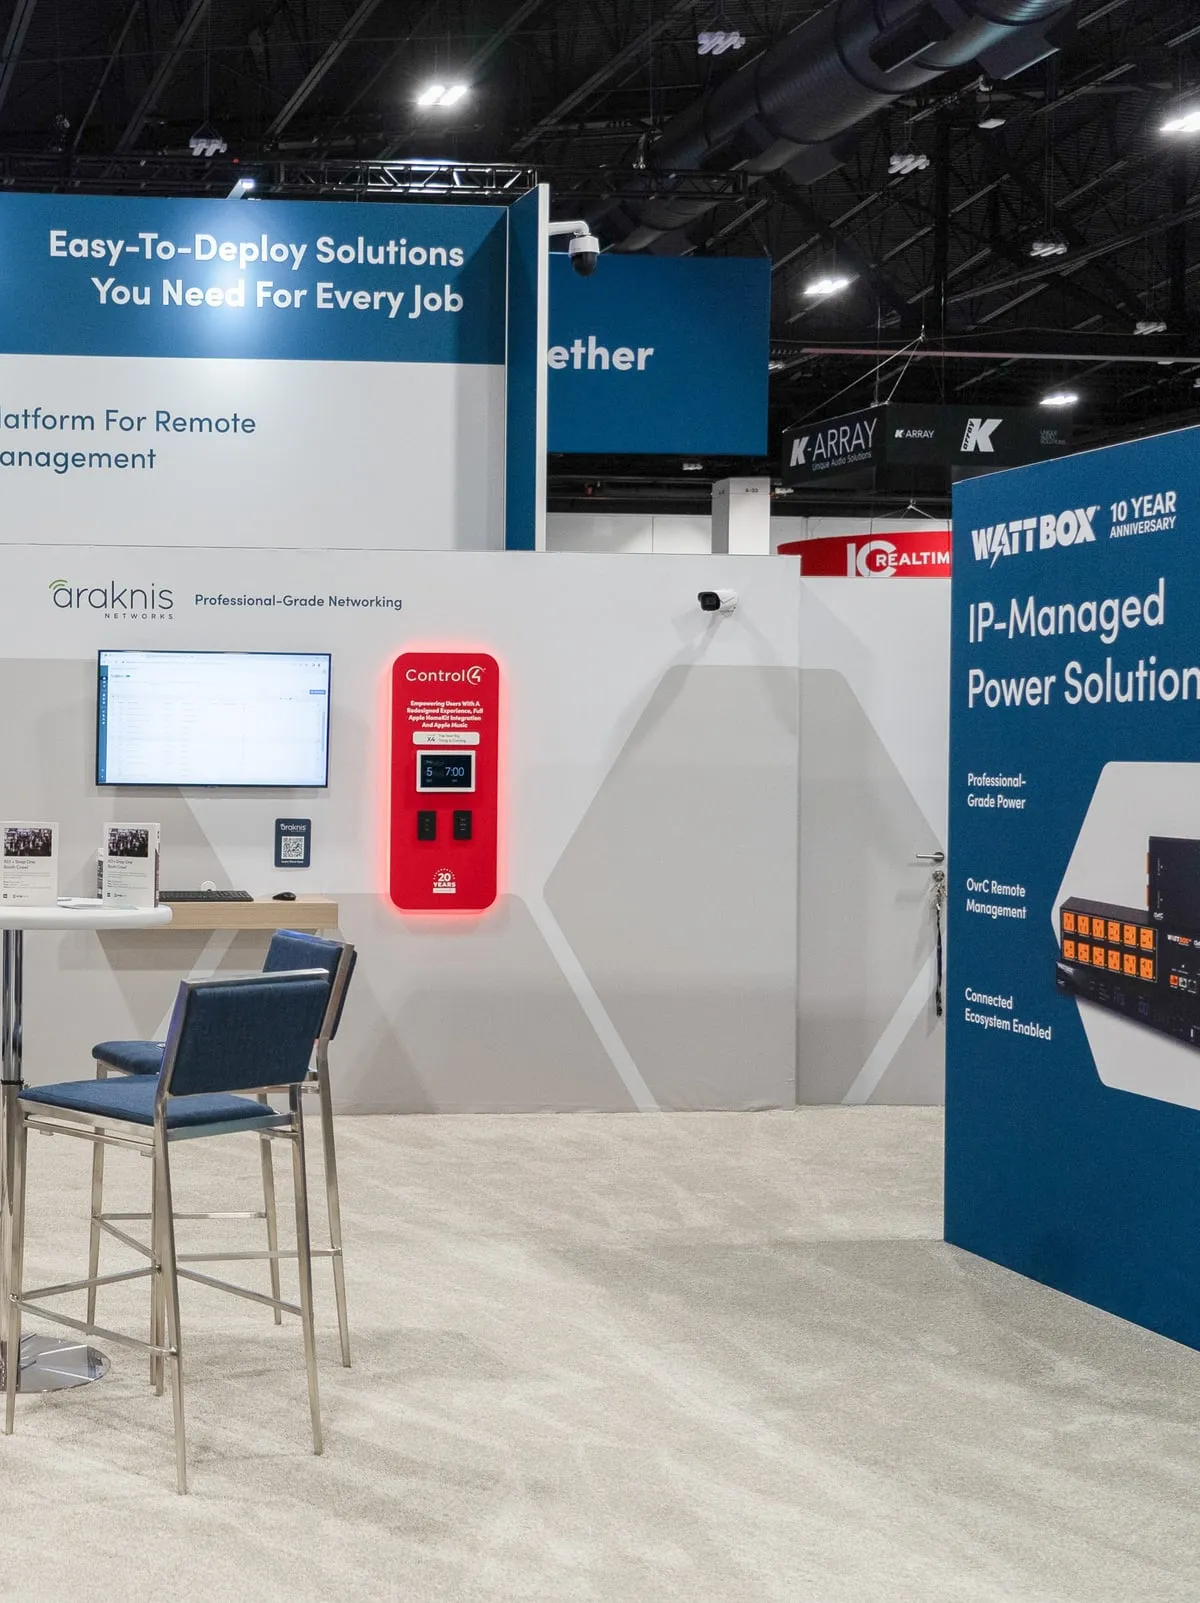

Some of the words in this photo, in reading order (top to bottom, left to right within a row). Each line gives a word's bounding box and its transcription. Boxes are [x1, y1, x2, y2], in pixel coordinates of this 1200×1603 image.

[49, 229, 307, 267] Easy-To-Deploy
[315, 235, 464, 267] Solutions
[91, 277, 151, 306] You
[162, 279, 245, 308] Need
[256, 280, 307, 309] For
[316, 282, 404, 318] Every
[410, 284, 464, 317] Job
[547, 336, 653, 371] ether
[105, 409, 147, 433] For
[155, 410, 256, 435] Remote
[789, 418, 877, 467] K-ARRAY
[812, 461, 830, 472] Unique
[831, 457, 846, 468] Audio
[847, 451, 872, 465] Solutions
[1110, 501, 1125, 523] 10
[1129, 491, 1177, 520] YEAR
[1109, 515, 1177, 539] ANNIVERSARY
[48, 579, 174, 610] araknis
[195, 593, 325, 608] Professional-Grade
[328, 595, 403, 611] Networking
[969, 577, 1165, 644] IP-Managed
[968, 668, 1056, 709] Power
[1064, 655, 1200, 705] Solution
[410, 700, 445, 708] Empowering
[426, 766, 433, 777] 5
[445, 766, 465, 777] 7:00
[967, 773, 1026, 788] Professional-
[967, 794, 995, 809] Grade
[997, 795, 1026, 810] Power
[437, 872, 452, 882] 20
[966, 877, 990, 893] OvrC
[991, 881, 1026, 898] Remote
[966, 899, 1026, 919] Management
[965, 987, 1013, 1010] Connected
[965, 1008, 1011, 1032] Ecosystem
[1013, 1019, 1052, 1041] Enabled
